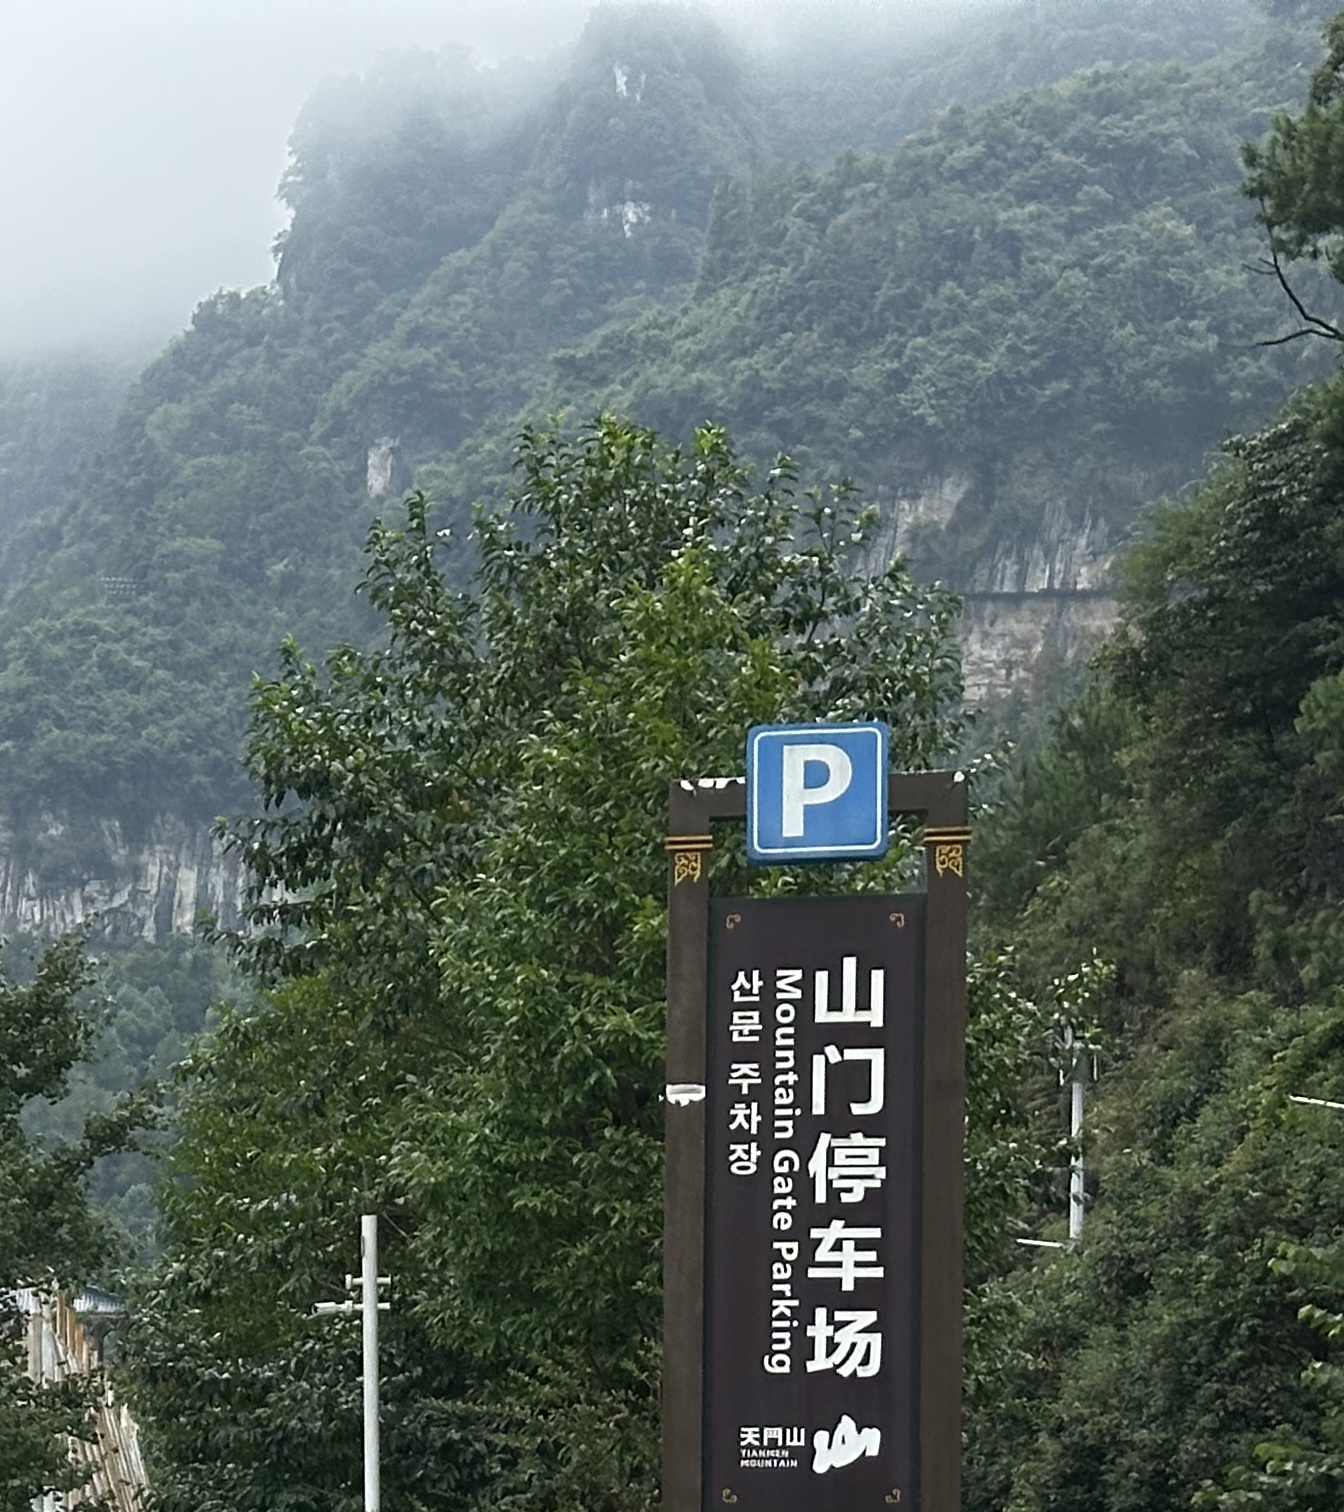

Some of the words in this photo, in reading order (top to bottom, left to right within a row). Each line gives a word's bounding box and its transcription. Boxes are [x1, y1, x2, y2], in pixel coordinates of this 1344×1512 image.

[782, 743, 853, 838] P
[729, 969, 763, 1042] 산문
[772, 968, 803, 1139] Mountain
[728, 1062, 762, 1175] 주차장
[805, 956, 887, 1378] 山门停车场
[771, 1149, 801, 1231] Gate
[763, 1241, 800, 1373] Parking
[740, 1458, 798, 1468] MOUNTAIN
